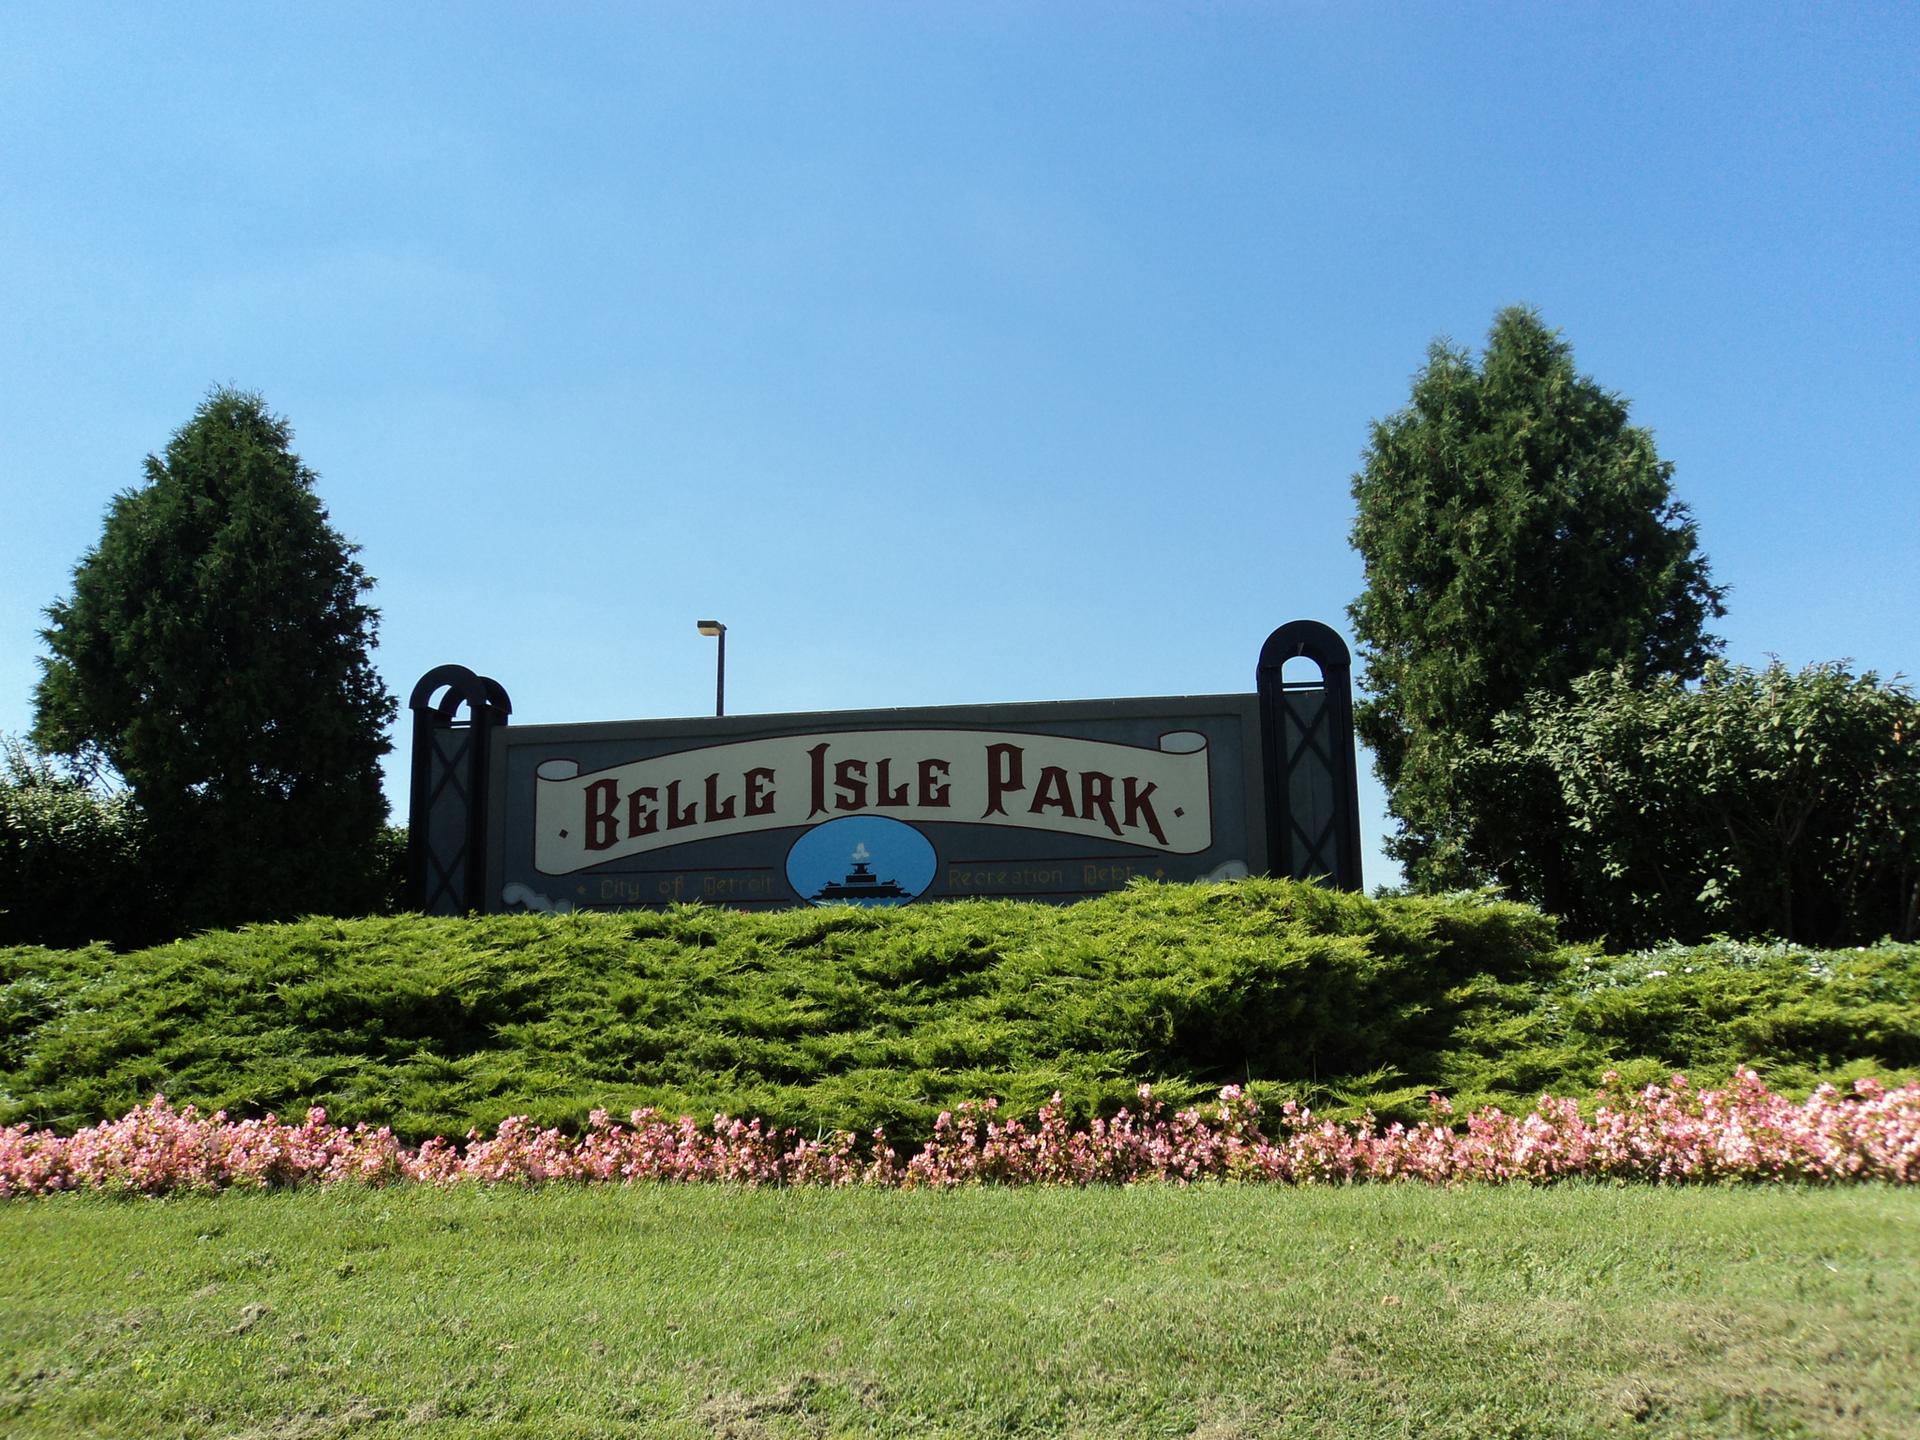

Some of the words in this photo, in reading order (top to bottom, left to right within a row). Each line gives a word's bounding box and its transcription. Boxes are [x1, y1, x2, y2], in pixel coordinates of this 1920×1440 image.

[584, 767, 777, 851] BELLE
[806, 742, 951, 820] ISLE
[980, 742, 1170, 846] PARK
[600, 878, 641, 901] City
[658, 875, 685, 898] of
[703, 874, 776, 897] Detroit
[949, 865, 1064, 889] Recreation
